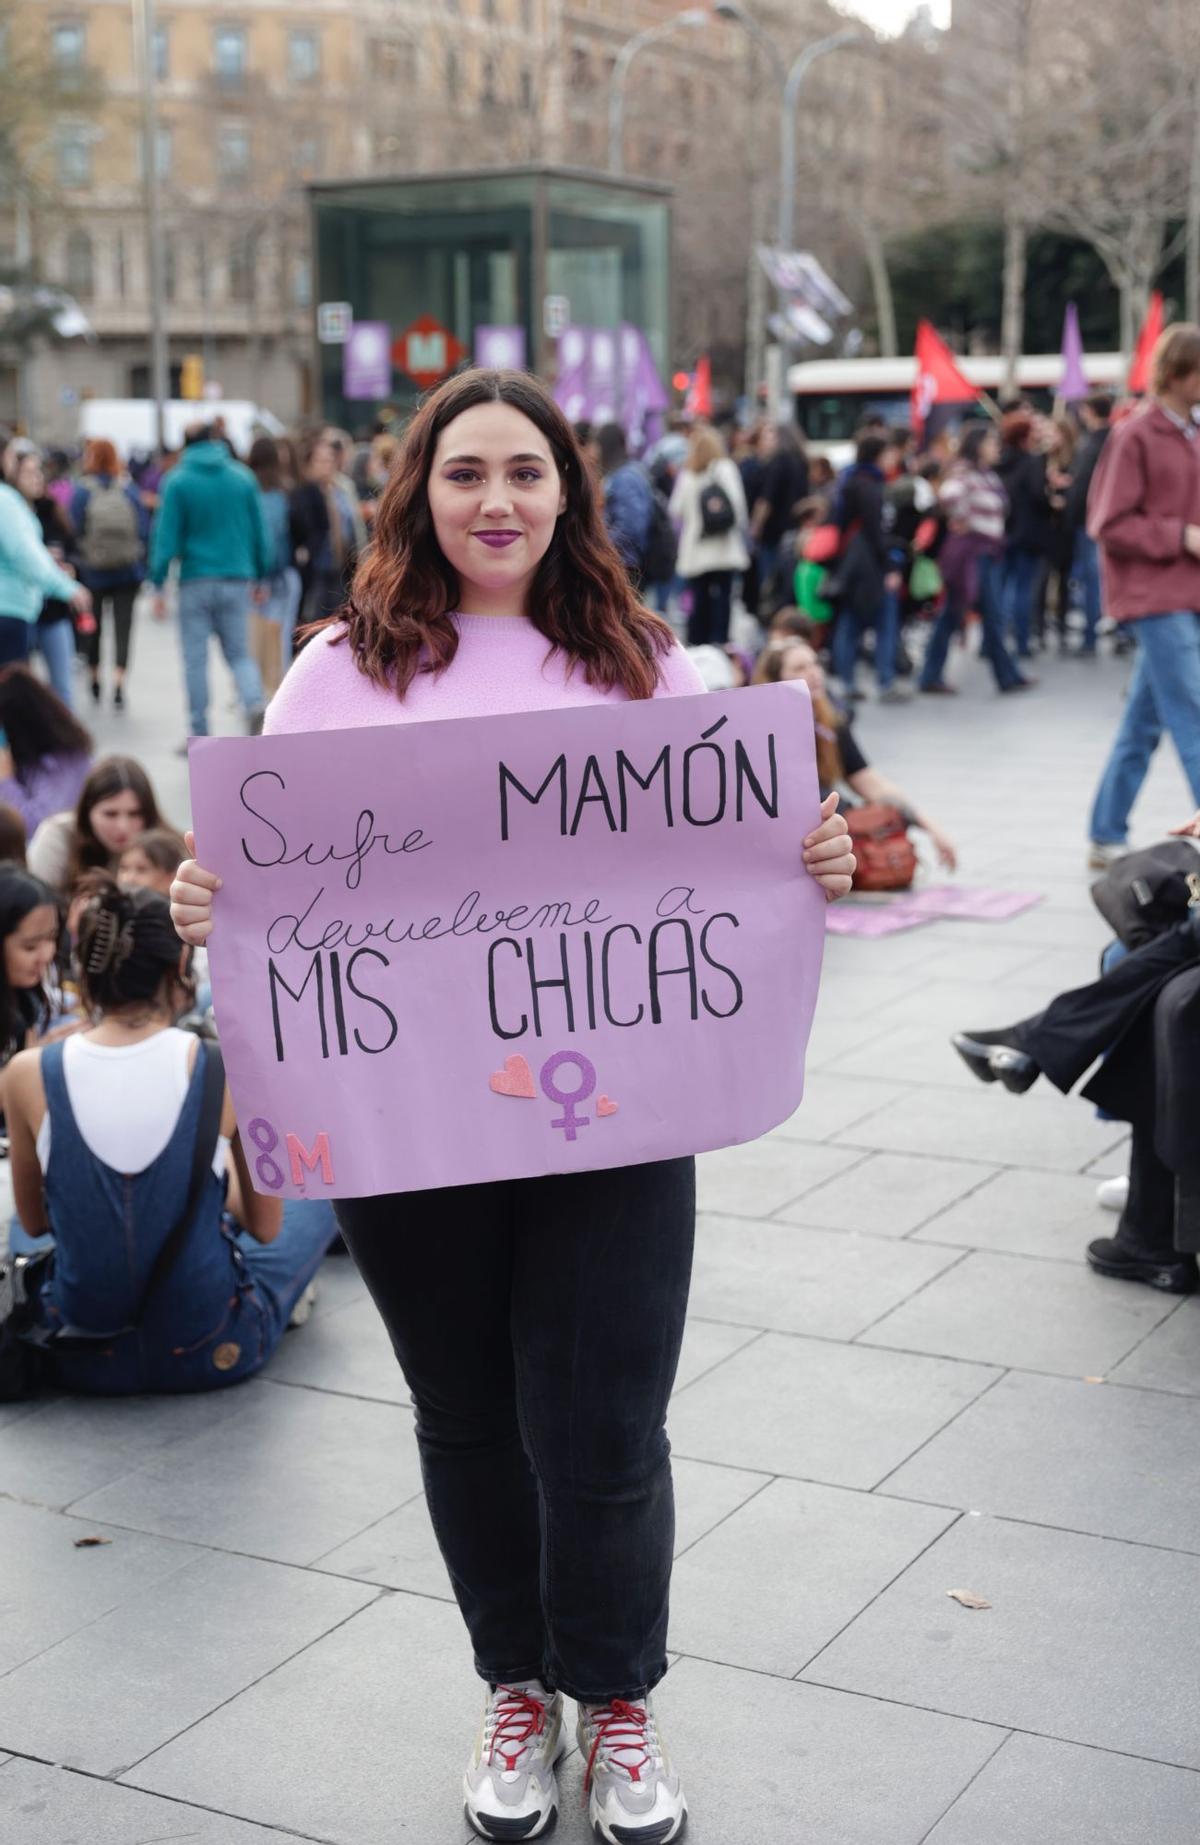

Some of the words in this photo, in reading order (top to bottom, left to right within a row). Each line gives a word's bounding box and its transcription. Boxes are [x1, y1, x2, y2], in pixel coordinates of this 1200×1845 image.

[240, 771, 433, 889] Sufre
[499, 715, 779, 841] MAMÓN
[656, 887, 706, 917] a
[268, 947, 398, 1062] MIS
[488, 912, 743, 1040] CHICAS
[247, 1118, 335, 1190] 8M
